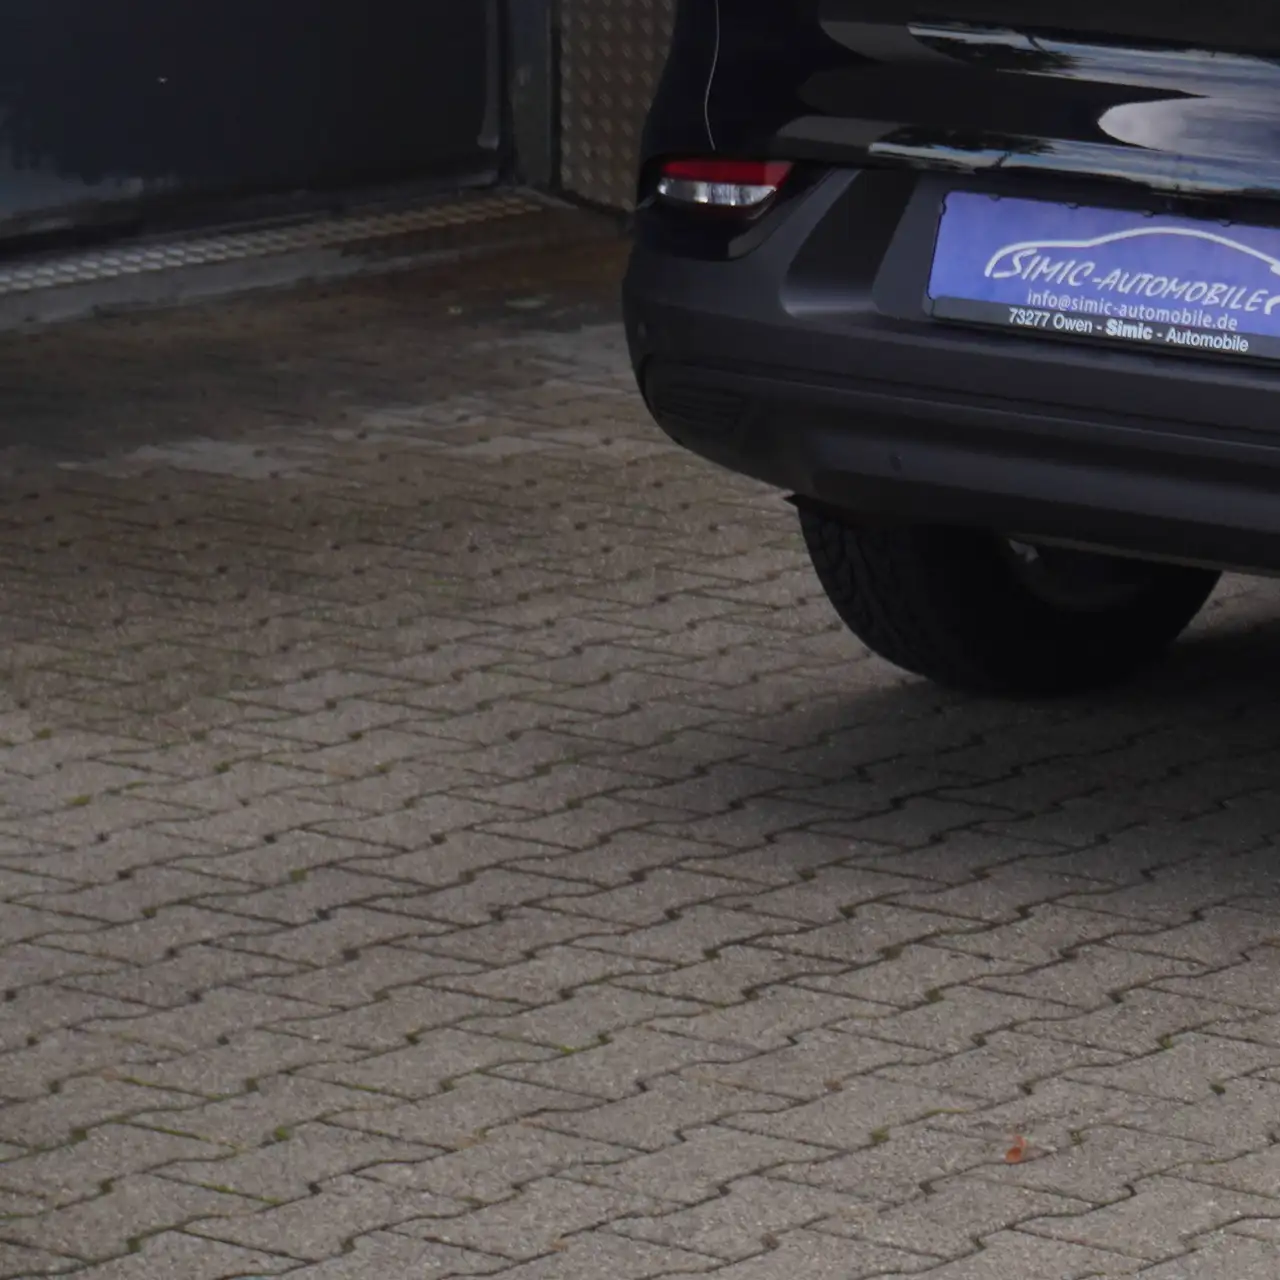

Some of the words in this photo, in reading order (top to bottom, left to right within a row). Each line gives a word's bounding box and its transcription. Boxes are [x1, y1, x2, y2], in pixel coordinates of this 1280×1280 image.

[992, 247, 1269, 312] SIMIC-AUTOMOBILE
[1008, 307, 1050, 327] 73277
[1052, 315, 1093, 334] Owen
[1105, 320, 1153, 340] Simic
[1165, 331, 1249, 352] Automobile
[1026, 290, 1238, 331] info@simic-automobile.de
